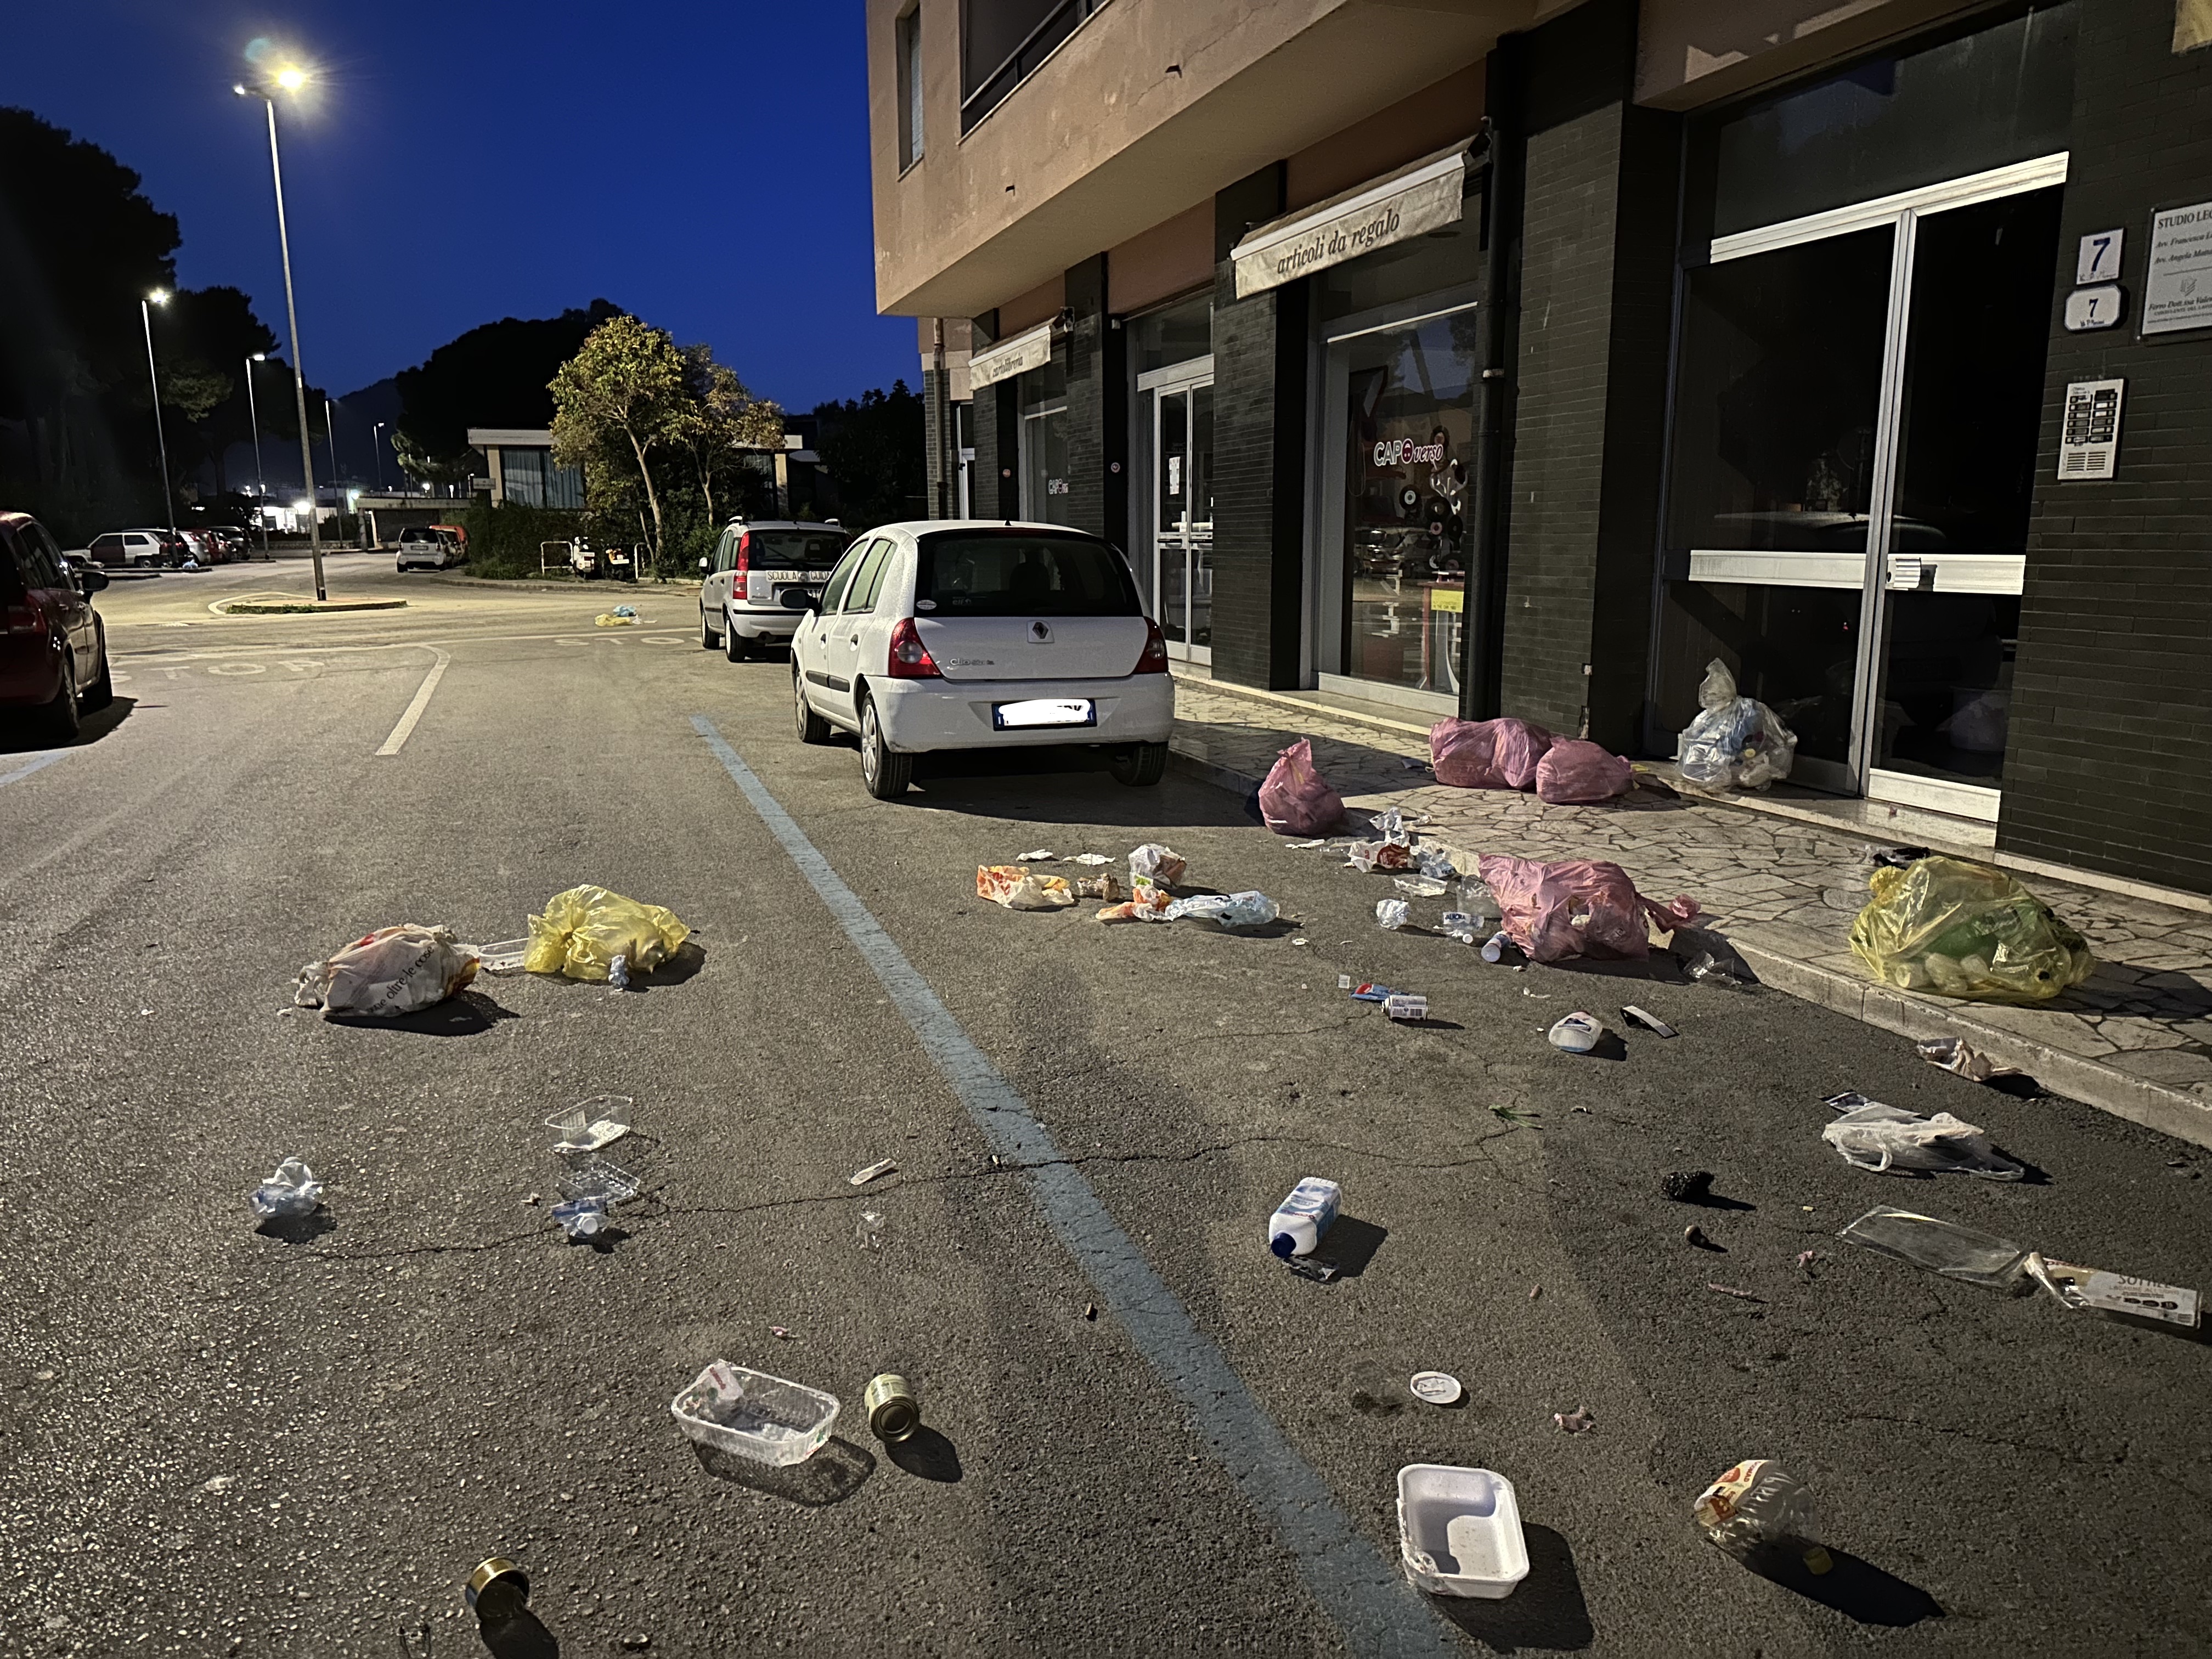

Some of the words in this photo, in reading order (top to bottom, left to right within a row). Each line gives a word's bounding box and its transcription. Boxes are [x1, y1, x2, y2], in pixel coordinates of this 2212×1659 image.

[2158, 212, 2194, 229] STUDIO
[1277, 241, 1324, 274] articoli
[1328, 229, 1347, 256] da
[1351, 209, 1401, 248] regalo
[2091, 237, 2111, 272] 7
[2089, 298, 2098, 318] 7
[768, 571, 797, 580] SCUOLA
[110, 659, 325, 684] STOP
[386, 976, 408, 999] oltre
[402, 967, 416, 978] le
[415, 946, 435, 967] cose
